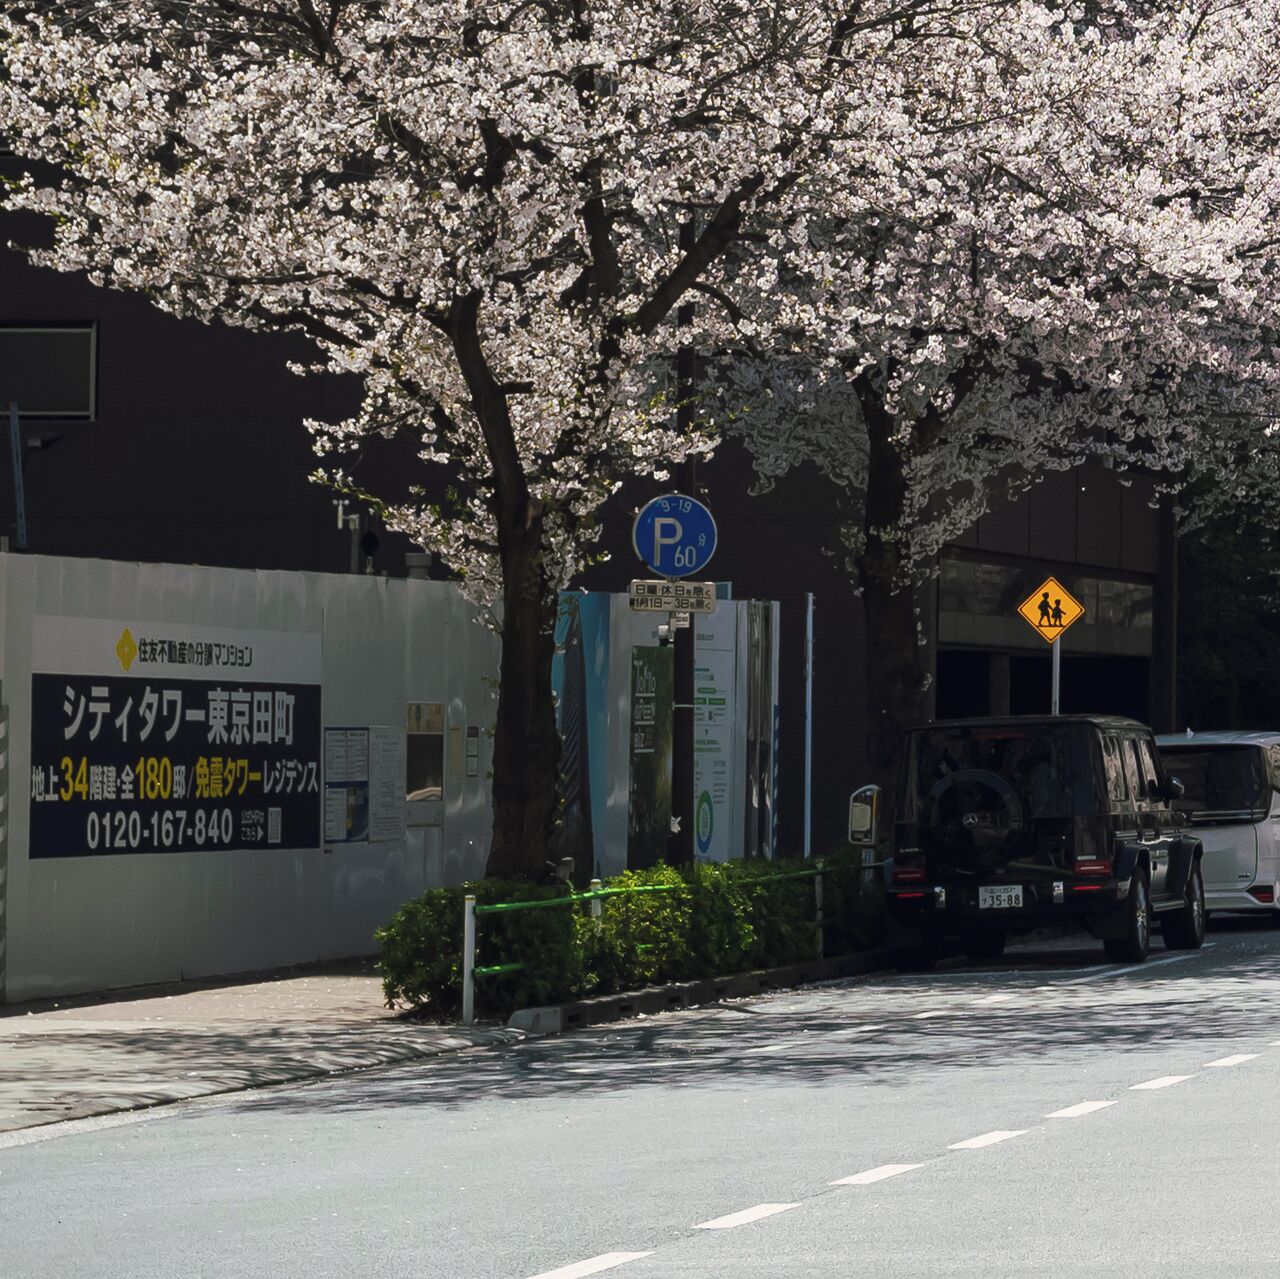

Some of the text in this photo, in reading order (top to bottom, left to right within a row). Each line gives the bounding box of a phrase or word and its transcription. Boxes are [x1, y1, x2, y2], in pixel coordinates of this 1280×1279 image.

[660, 500, 692, 513] 9-19
[654, 517, 683, 567] P
[674, 545, 696, 568] 60
[138, 638, 253, 668] 住友不動産の分譲マンション
[63, 685, 296, 745] シティタワー東京田町
[87, 808, 233, 849] 0120-167-840
